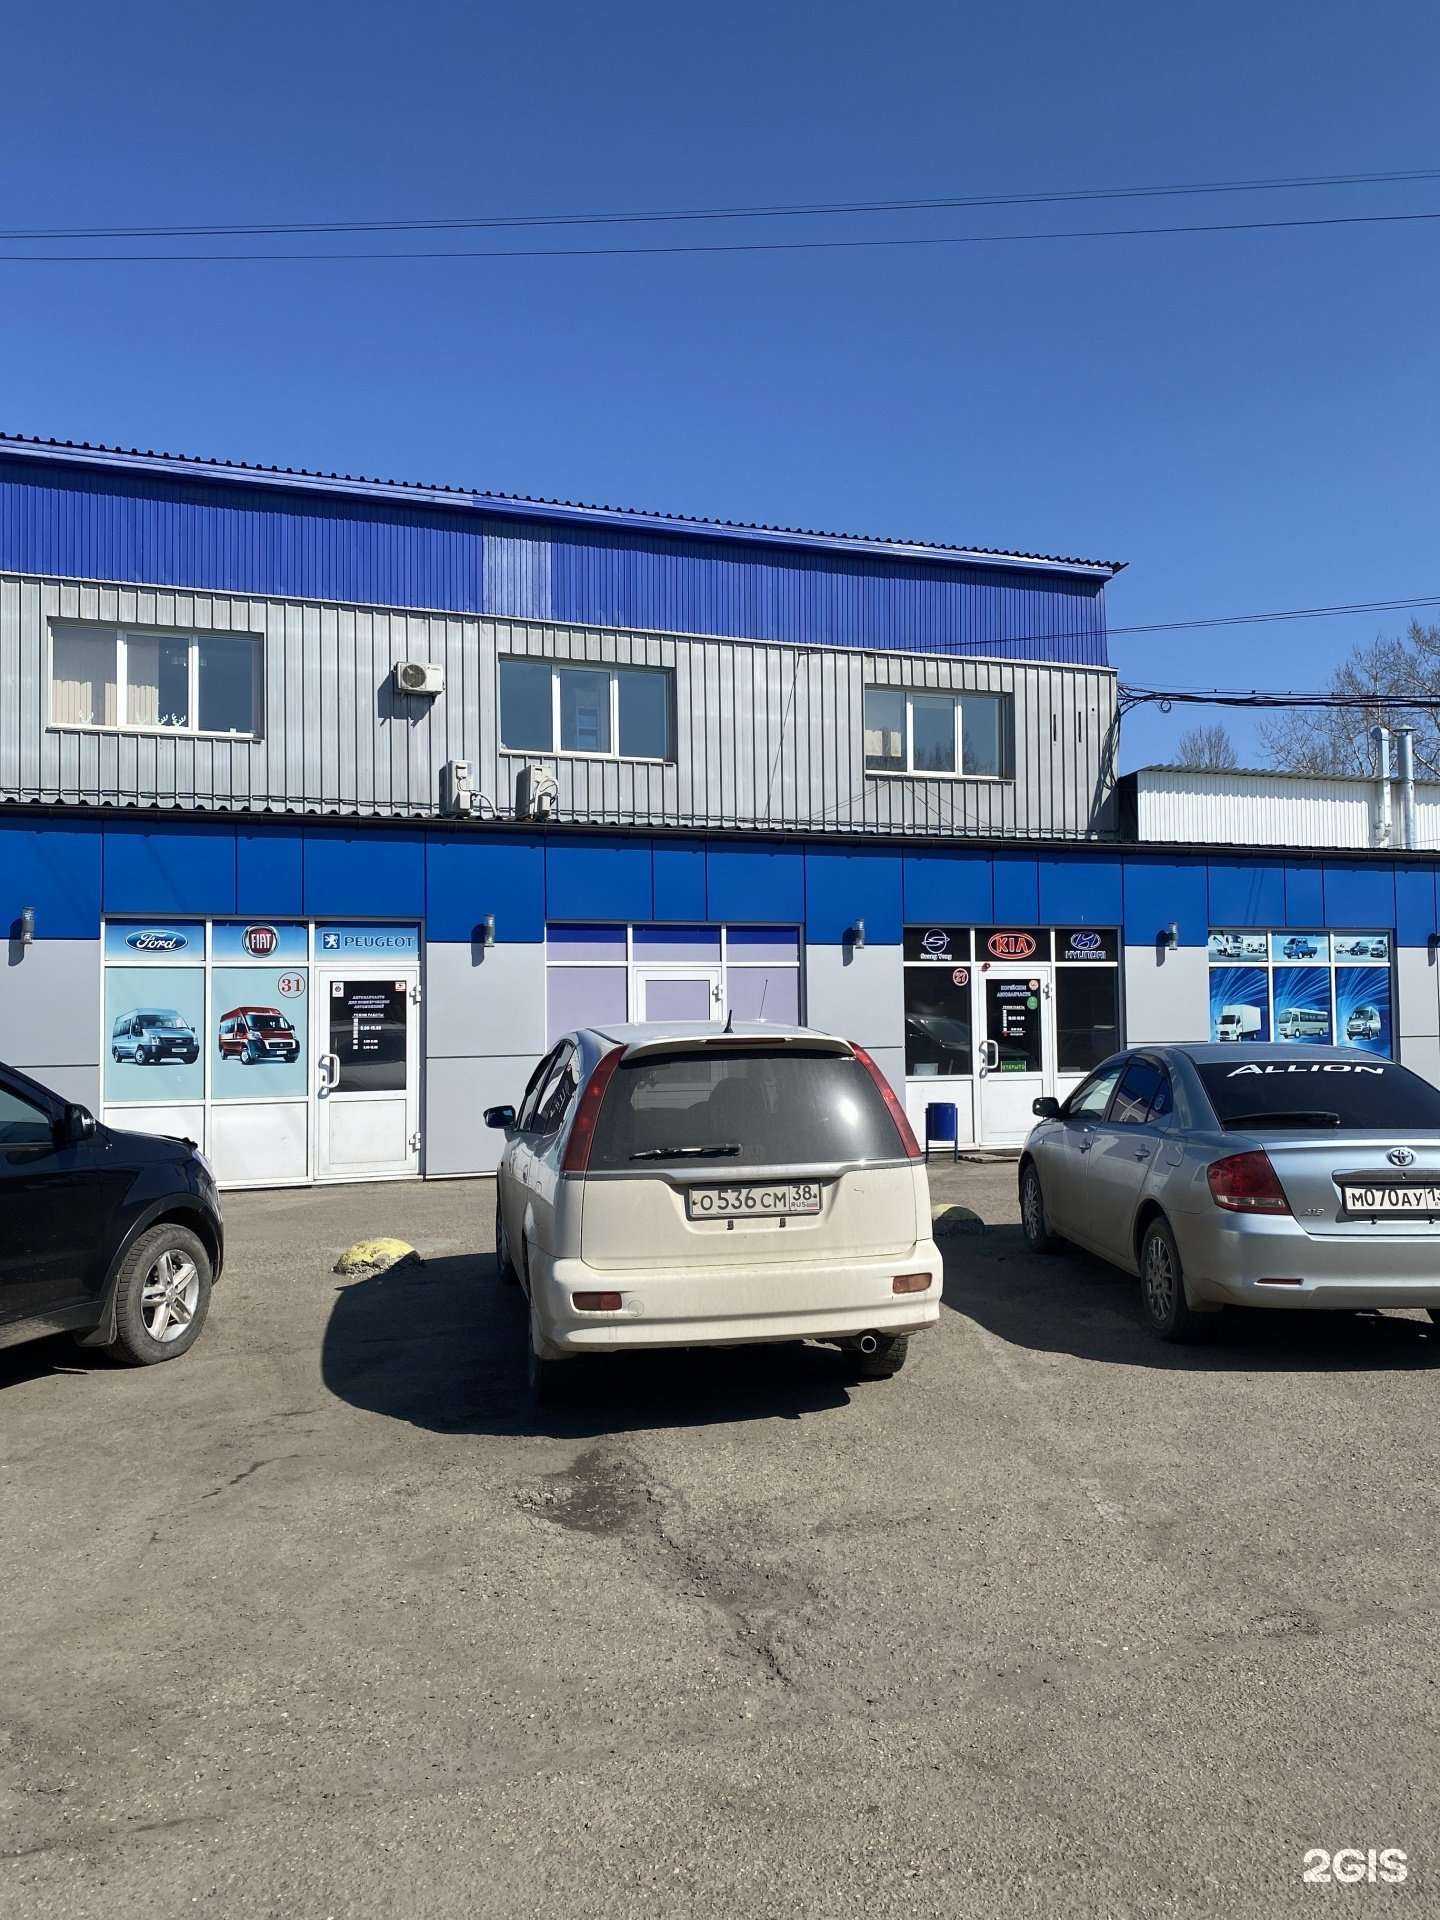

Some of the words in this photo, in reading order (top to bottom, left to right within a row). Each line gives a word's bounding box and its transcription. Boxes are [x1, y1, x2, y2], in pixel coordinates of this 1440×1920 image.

[136, 932, 177, 950] Ford
[250, 933, 272, 949] FIAT
[344, 936, 415, 947] PEUGEOT
[996, 936, 1029, 954] KIA
[281, 978, 301, 992] 31
[1226, 1064, 1385, 1078] ALLION
[792, 1185, 812, 1200] 38
